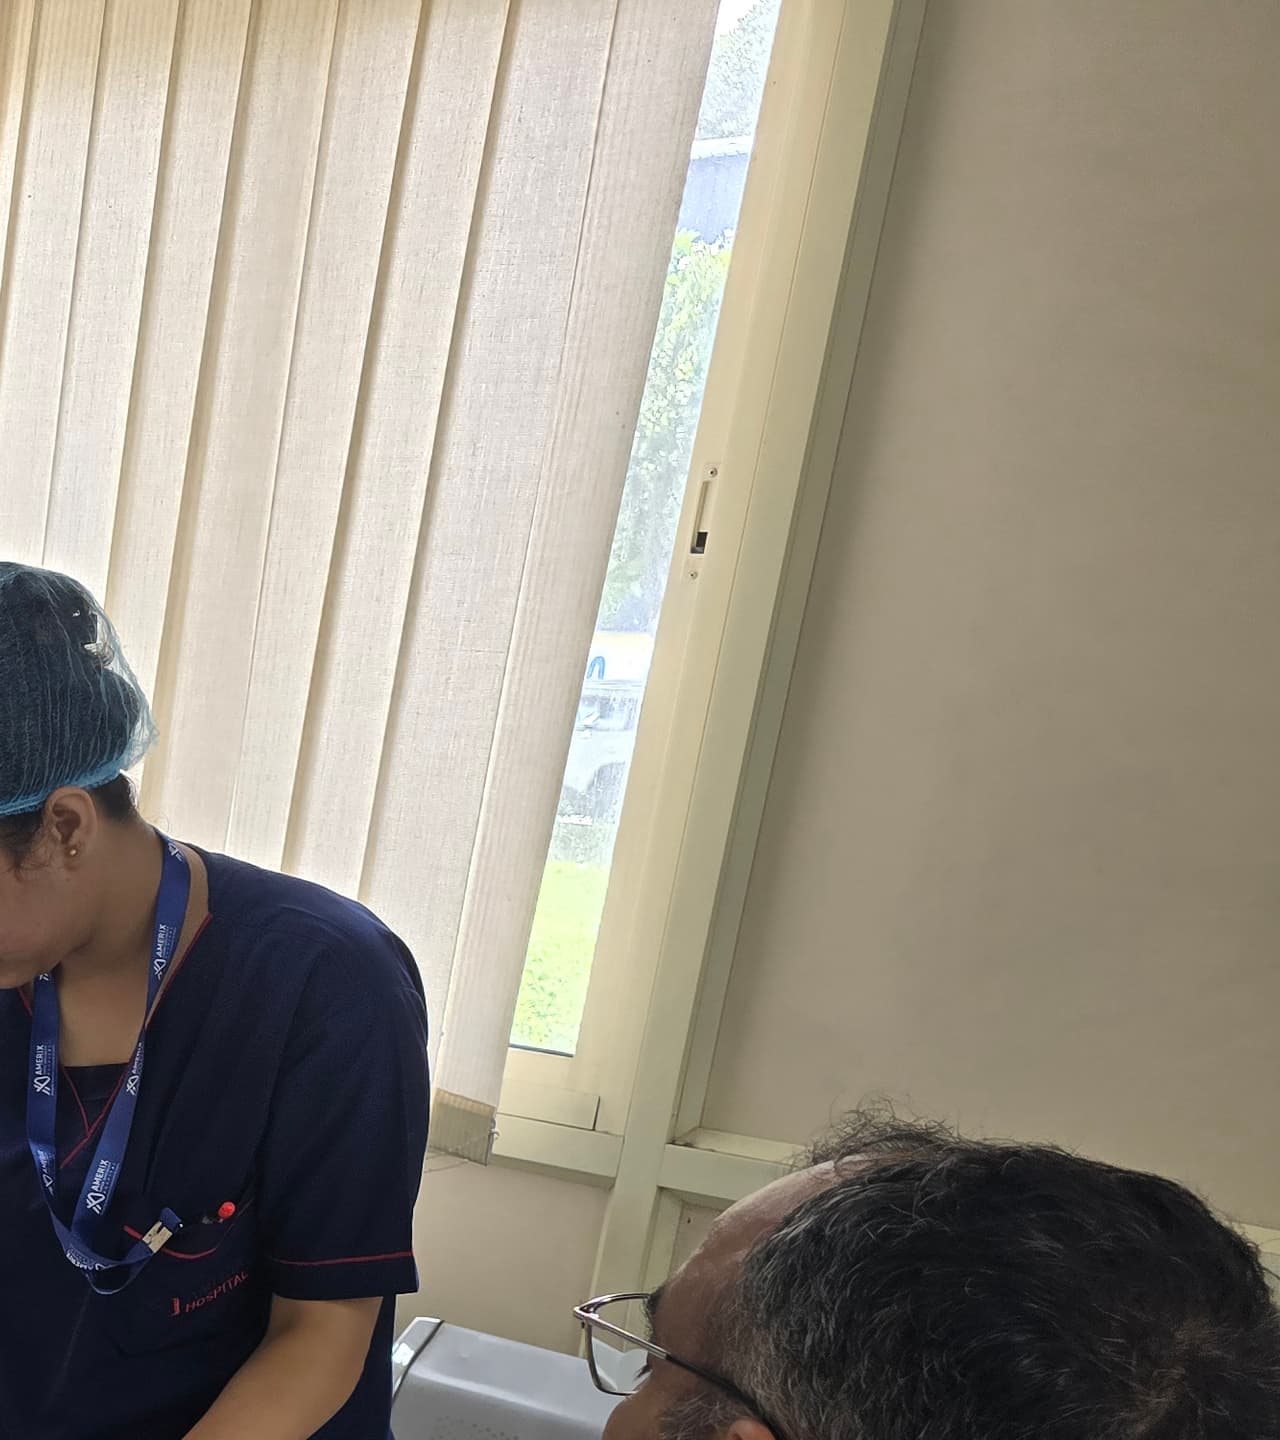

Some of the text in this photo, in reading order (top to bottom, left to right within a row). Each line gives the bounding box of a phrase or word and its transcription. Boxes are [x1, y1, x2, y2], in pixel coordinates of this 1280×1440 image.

[155, 924, 169, 957] AMERIX
[34, 1044, 45, 1075] AMERIX
[91, 1159, 111, 1192] AMERIX
[185, 1271, 249, 1313] HOSPITAL
